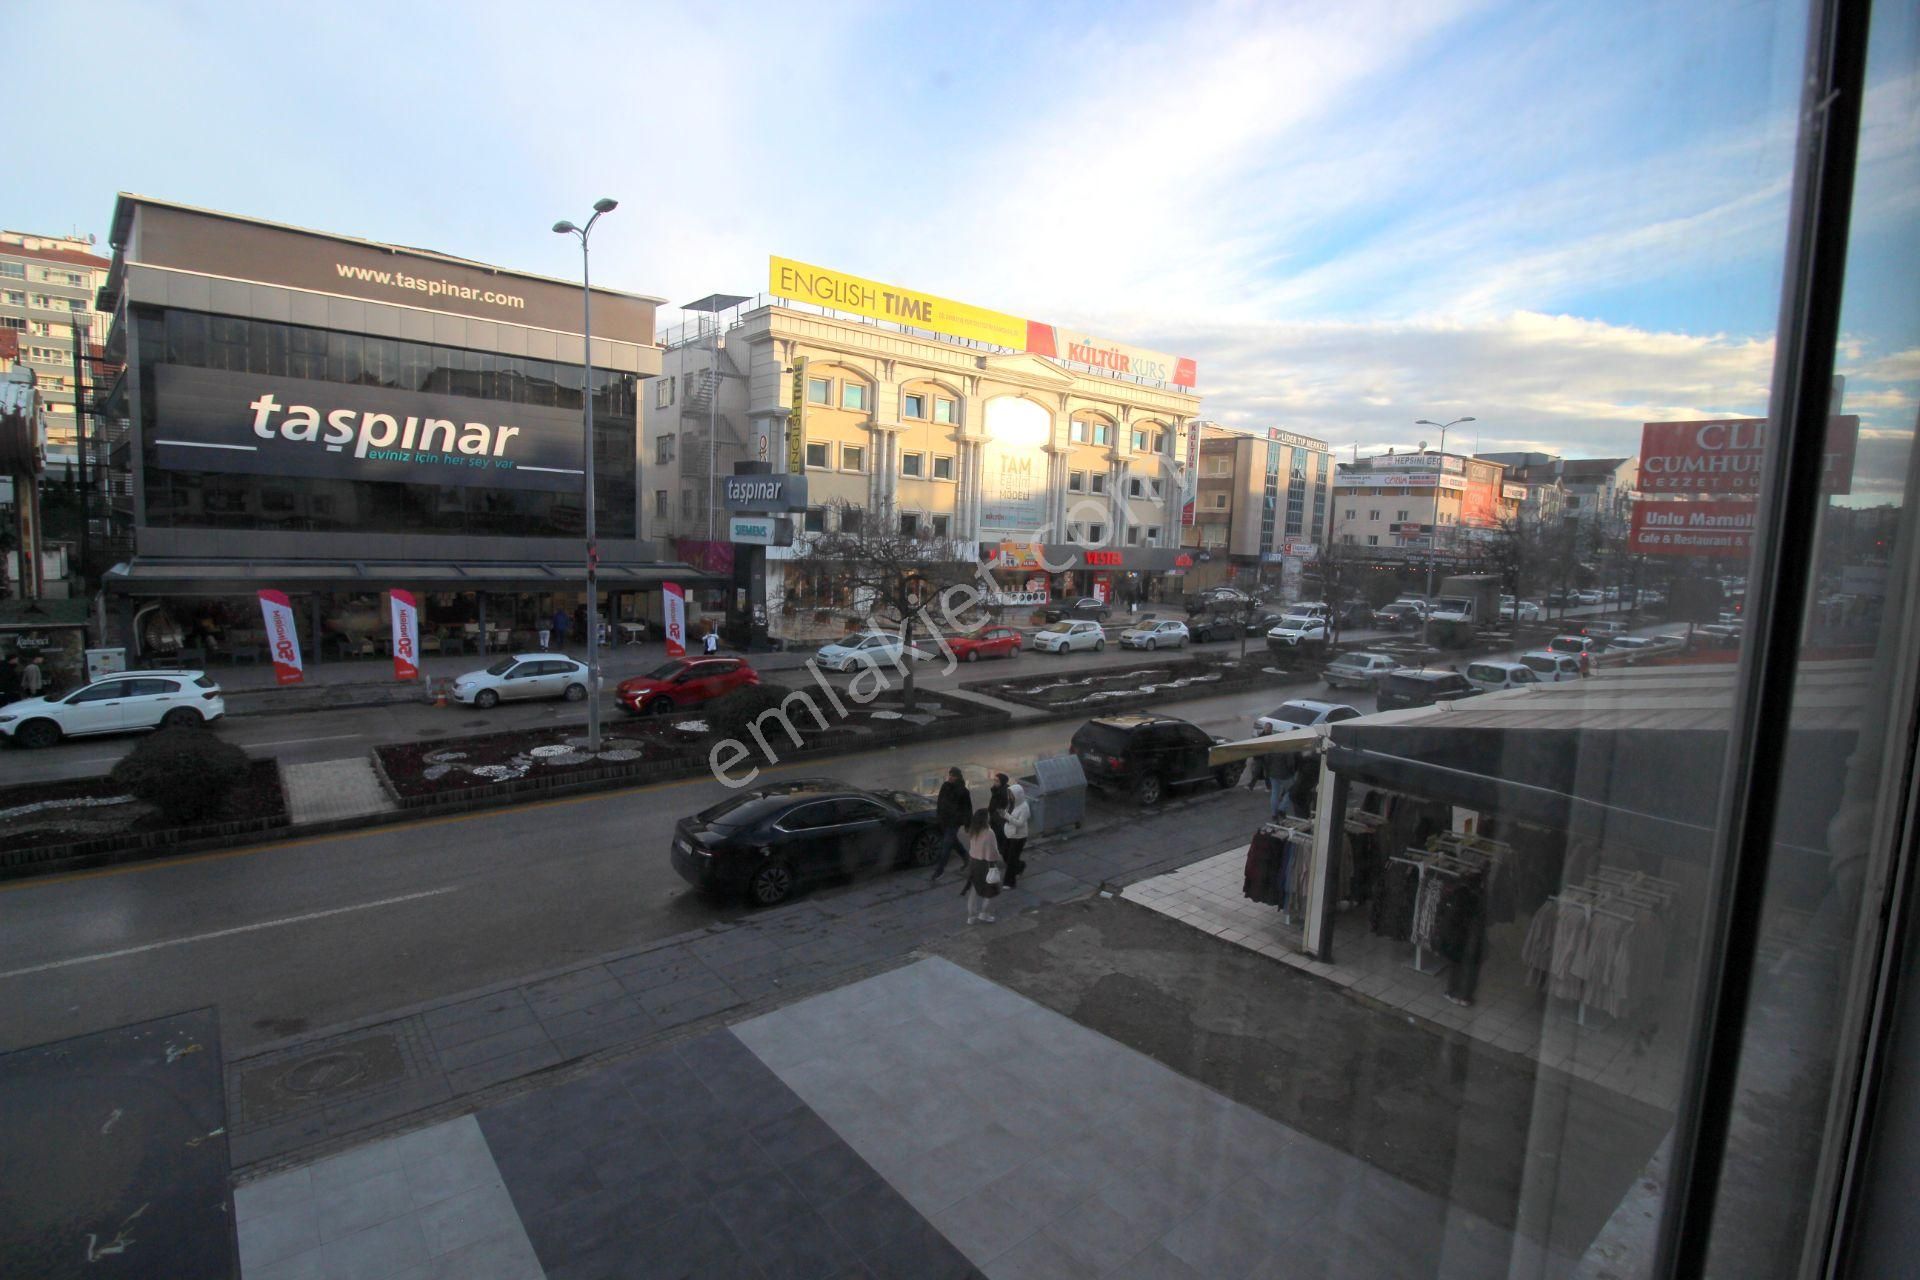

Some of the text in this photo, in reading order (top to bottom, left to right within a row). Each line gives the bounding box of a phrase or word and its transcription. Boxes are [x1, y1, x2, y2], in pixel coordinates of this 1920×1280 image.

[336, 263, 525, 309] www.taspinar.com
[780, 266, 876, 311] ENGLISH
[882, 291, 933, 324] TIME
[1068, 342, 1166, 380] KÜLTÜR KURS
[250, 394, 520, 459] taşpınar
[791, 406, 801, 473] ENGLISH
[369, 450, 410, 462] eviniz
[415, 452, 439, 465] için
[444, 455, 464, 466] her
[495, 459, 514, 469] var
[728, 480, 782, 504] taşpınar
[1643, 477, 1720, 487] LEZZET
[735, 525, 767, 537] SIEMENS
[1638, 532, 1661, 544] Cafe
[1663, 534, 1672, 543] &
[1674, 534, 1731, 546] Restaurant
